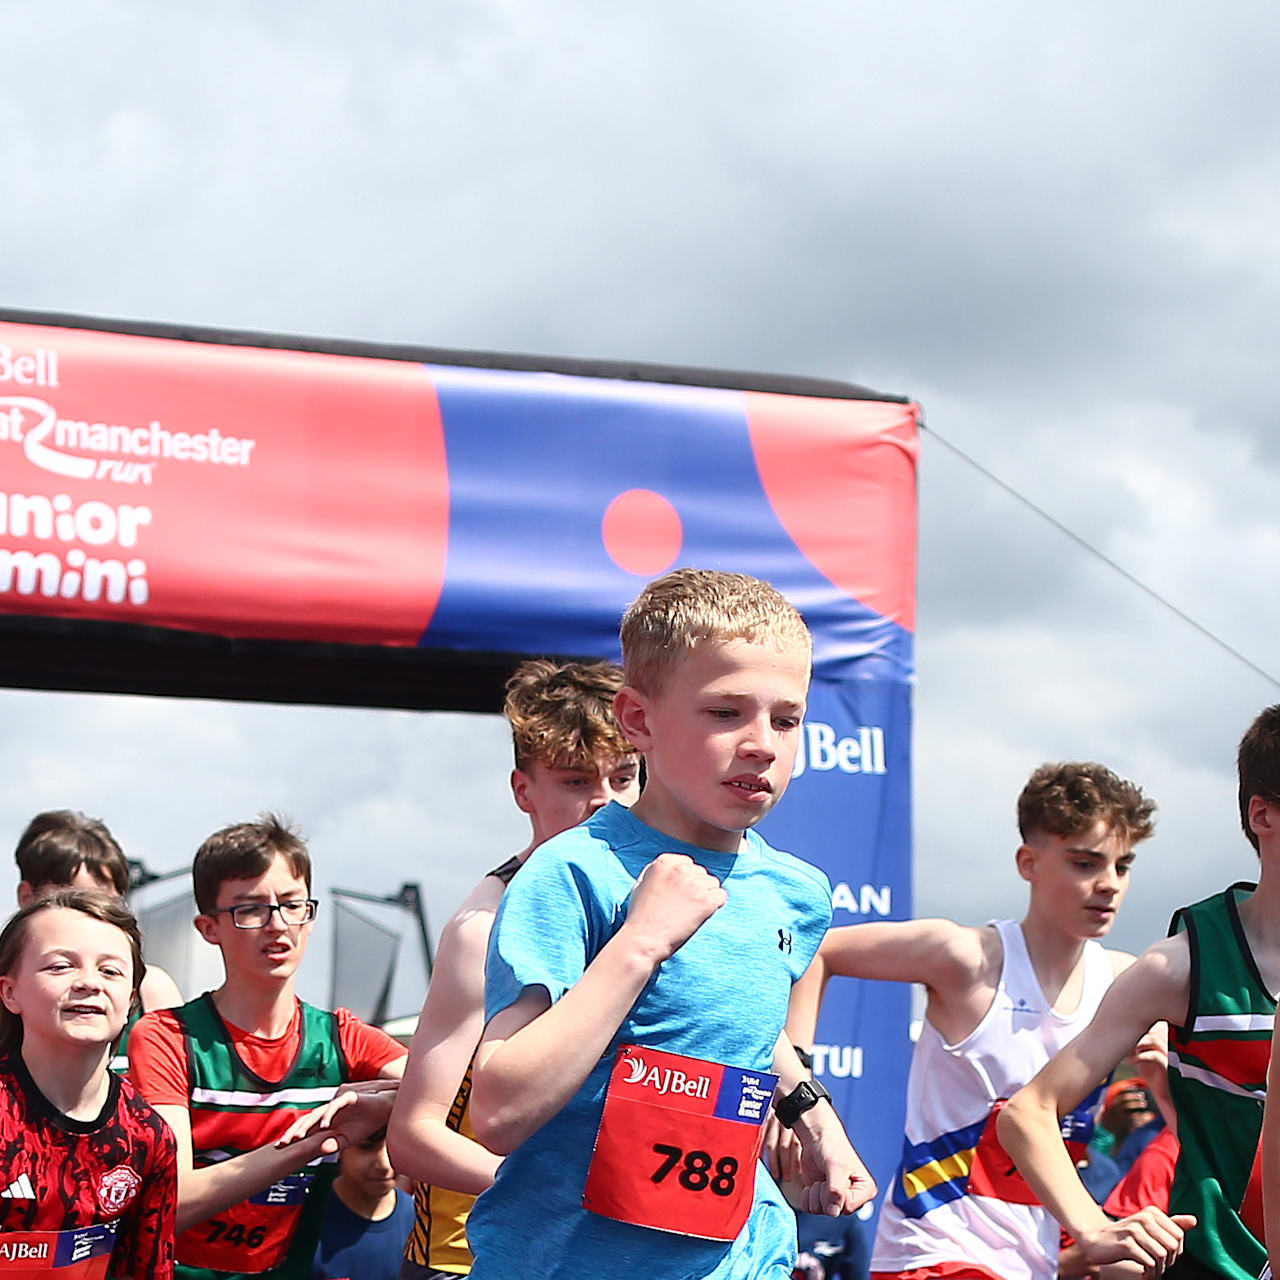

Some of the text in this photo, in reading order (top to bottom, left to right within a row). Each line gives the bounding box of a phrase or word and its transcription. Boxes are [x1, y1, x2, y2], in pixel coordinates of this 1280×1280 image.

[54, 419, 255, 466] manchester
[94, 459, 154, 486] run
[810, 1044, 864, 1079] TUI
[650, 1143, 738, 1196] 788
[205, 1220, 267, 1249] 746
